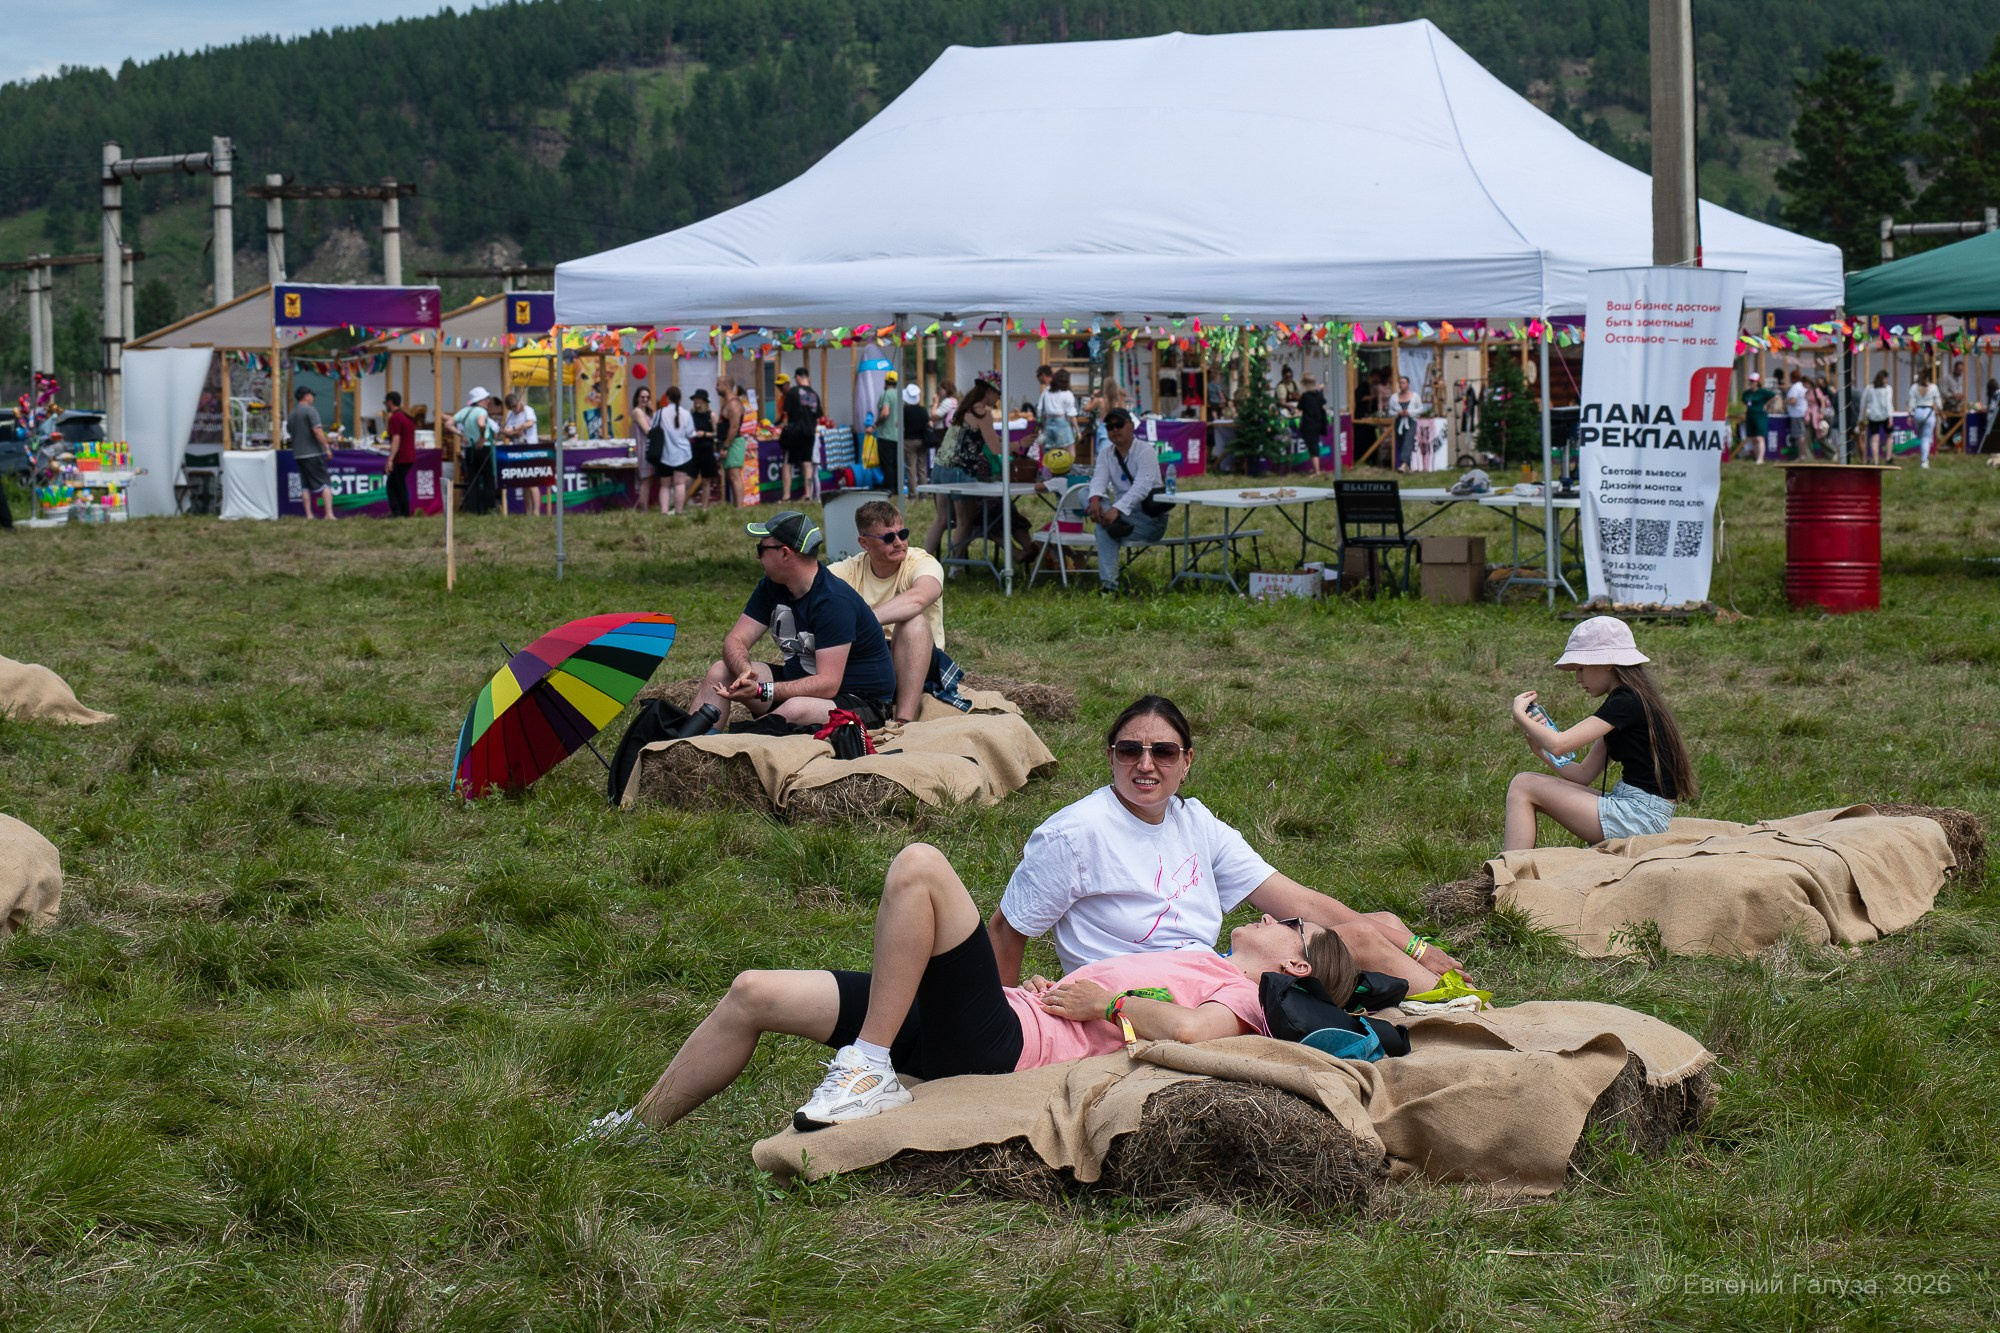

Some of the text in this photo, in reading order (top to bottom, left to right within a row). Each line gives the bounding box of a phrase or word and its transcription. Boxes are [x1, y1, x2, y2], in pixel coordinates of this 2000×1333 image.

[1606, 300, 1632, 311] Ваш
[1634, 299, 1673, 311] бизнес
[1605, 316, 1633, 327] быть
[1605, 332, 1665, 344] Остальное
[1682, 336, 1696, 345] на
[1580, 427, 1722, 450] РЕКЛАМА
[501, 466, 553, 479] ЯРМАРКА
[1645, 469, 1687, 478] вывески
[1644, 483, 1683, 492] монтаж
[1668, 499, 1685, 508] под
